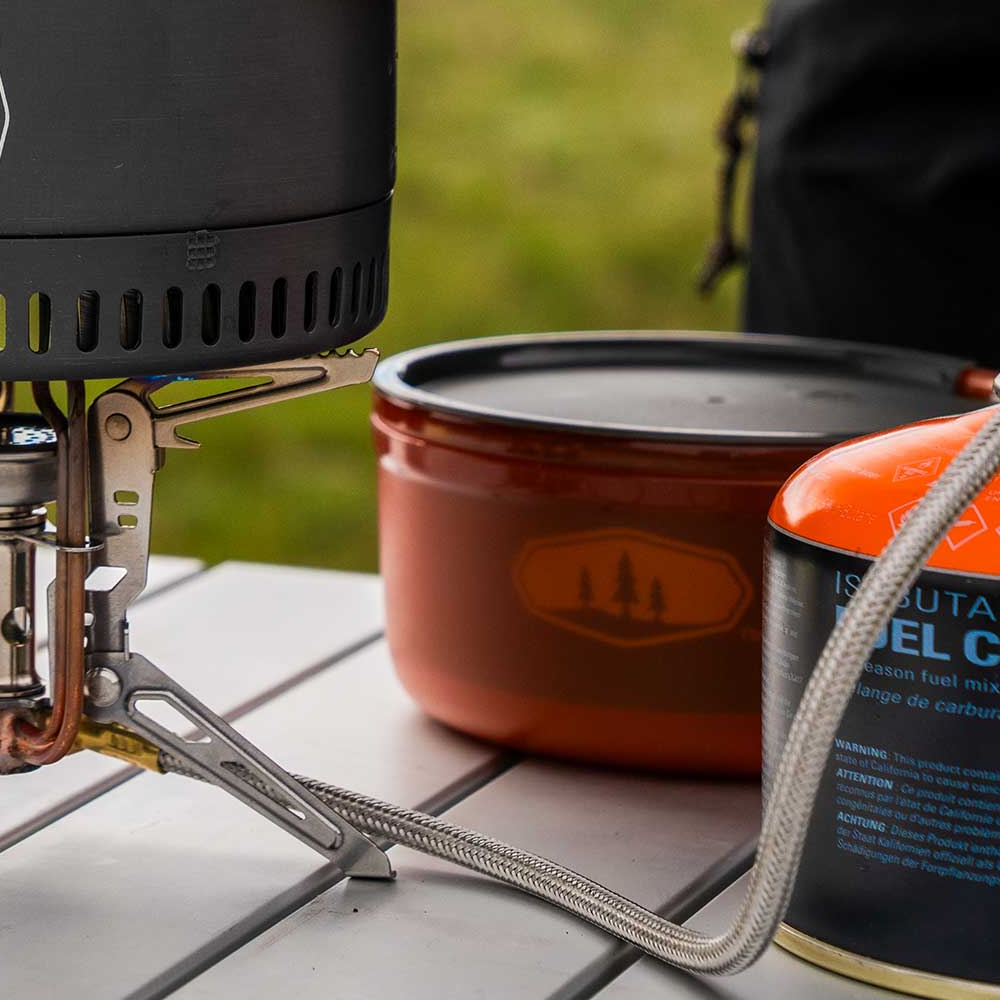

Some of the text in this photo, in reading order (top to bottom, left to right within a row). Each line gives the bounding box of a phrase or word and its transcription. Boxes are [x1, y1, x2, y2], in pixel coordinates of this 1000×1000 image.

[921, 669, 958, 689] fuel
[907, 694, 930, 709] de
[859, 757, 868, 768] of
[870, 760, 919, 781] California
[922, 772, 933, 783] to
[935, 775, 969, 790] cause
[894, 753, 915, 766] This
[917, 757, 960, 777] product
